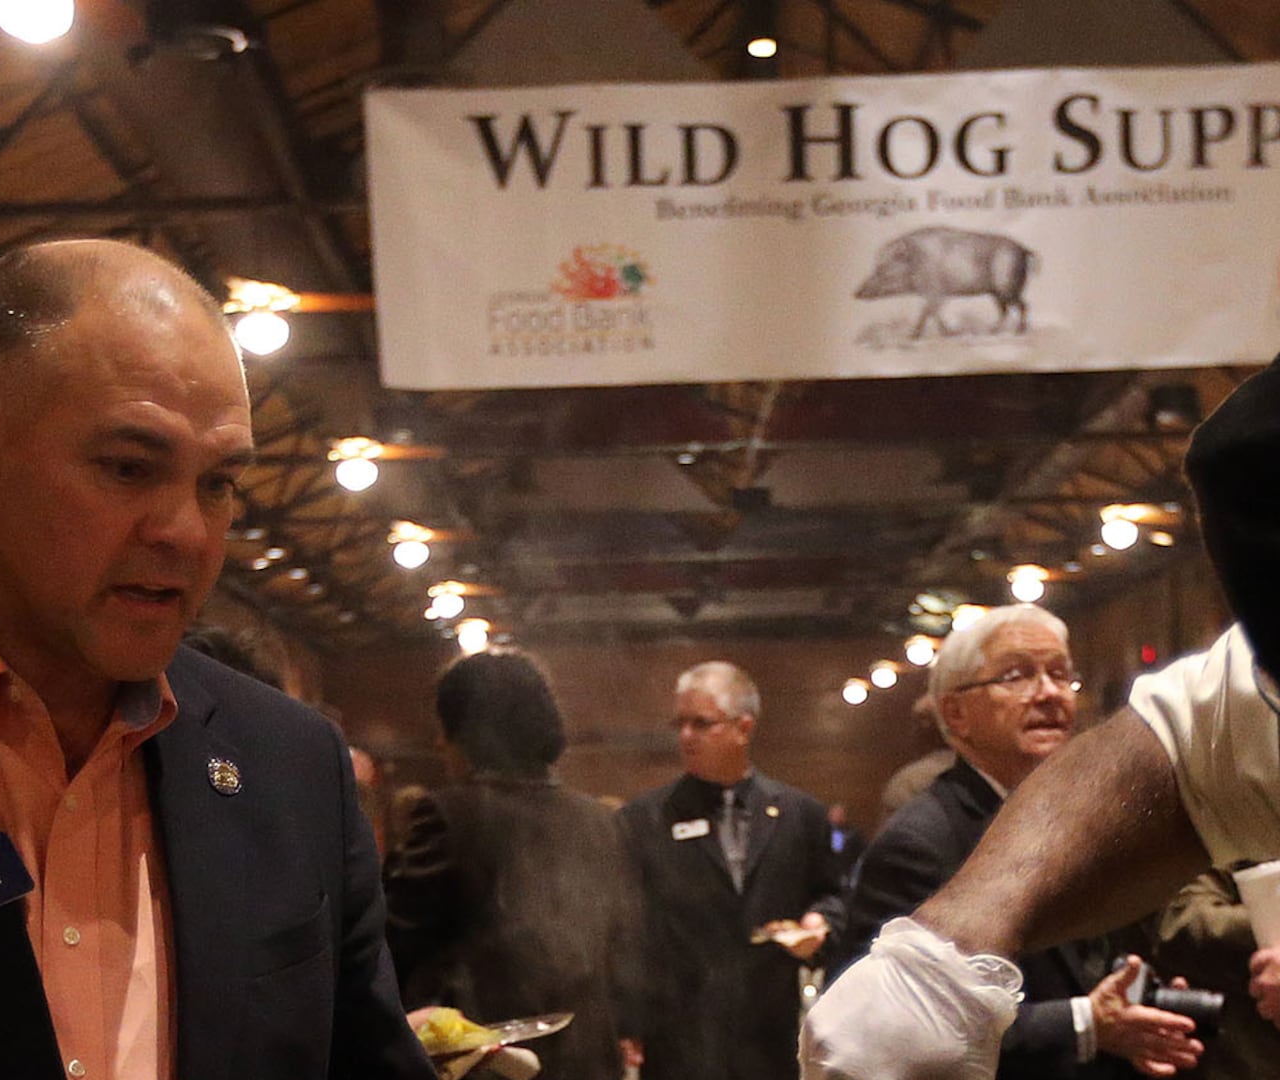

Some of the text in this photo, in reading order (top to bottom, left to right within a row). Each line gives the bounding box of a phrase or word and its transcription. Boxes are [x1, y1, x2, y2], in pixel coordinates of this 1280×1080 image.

[467, 109, 740, 190] WILD
[782, 101, 1010, 182] HOG
[810, 192, 917, 218] Georgia
[926, 188, 996, 211] Food
[1001, 186, 1070, 209] Bank
